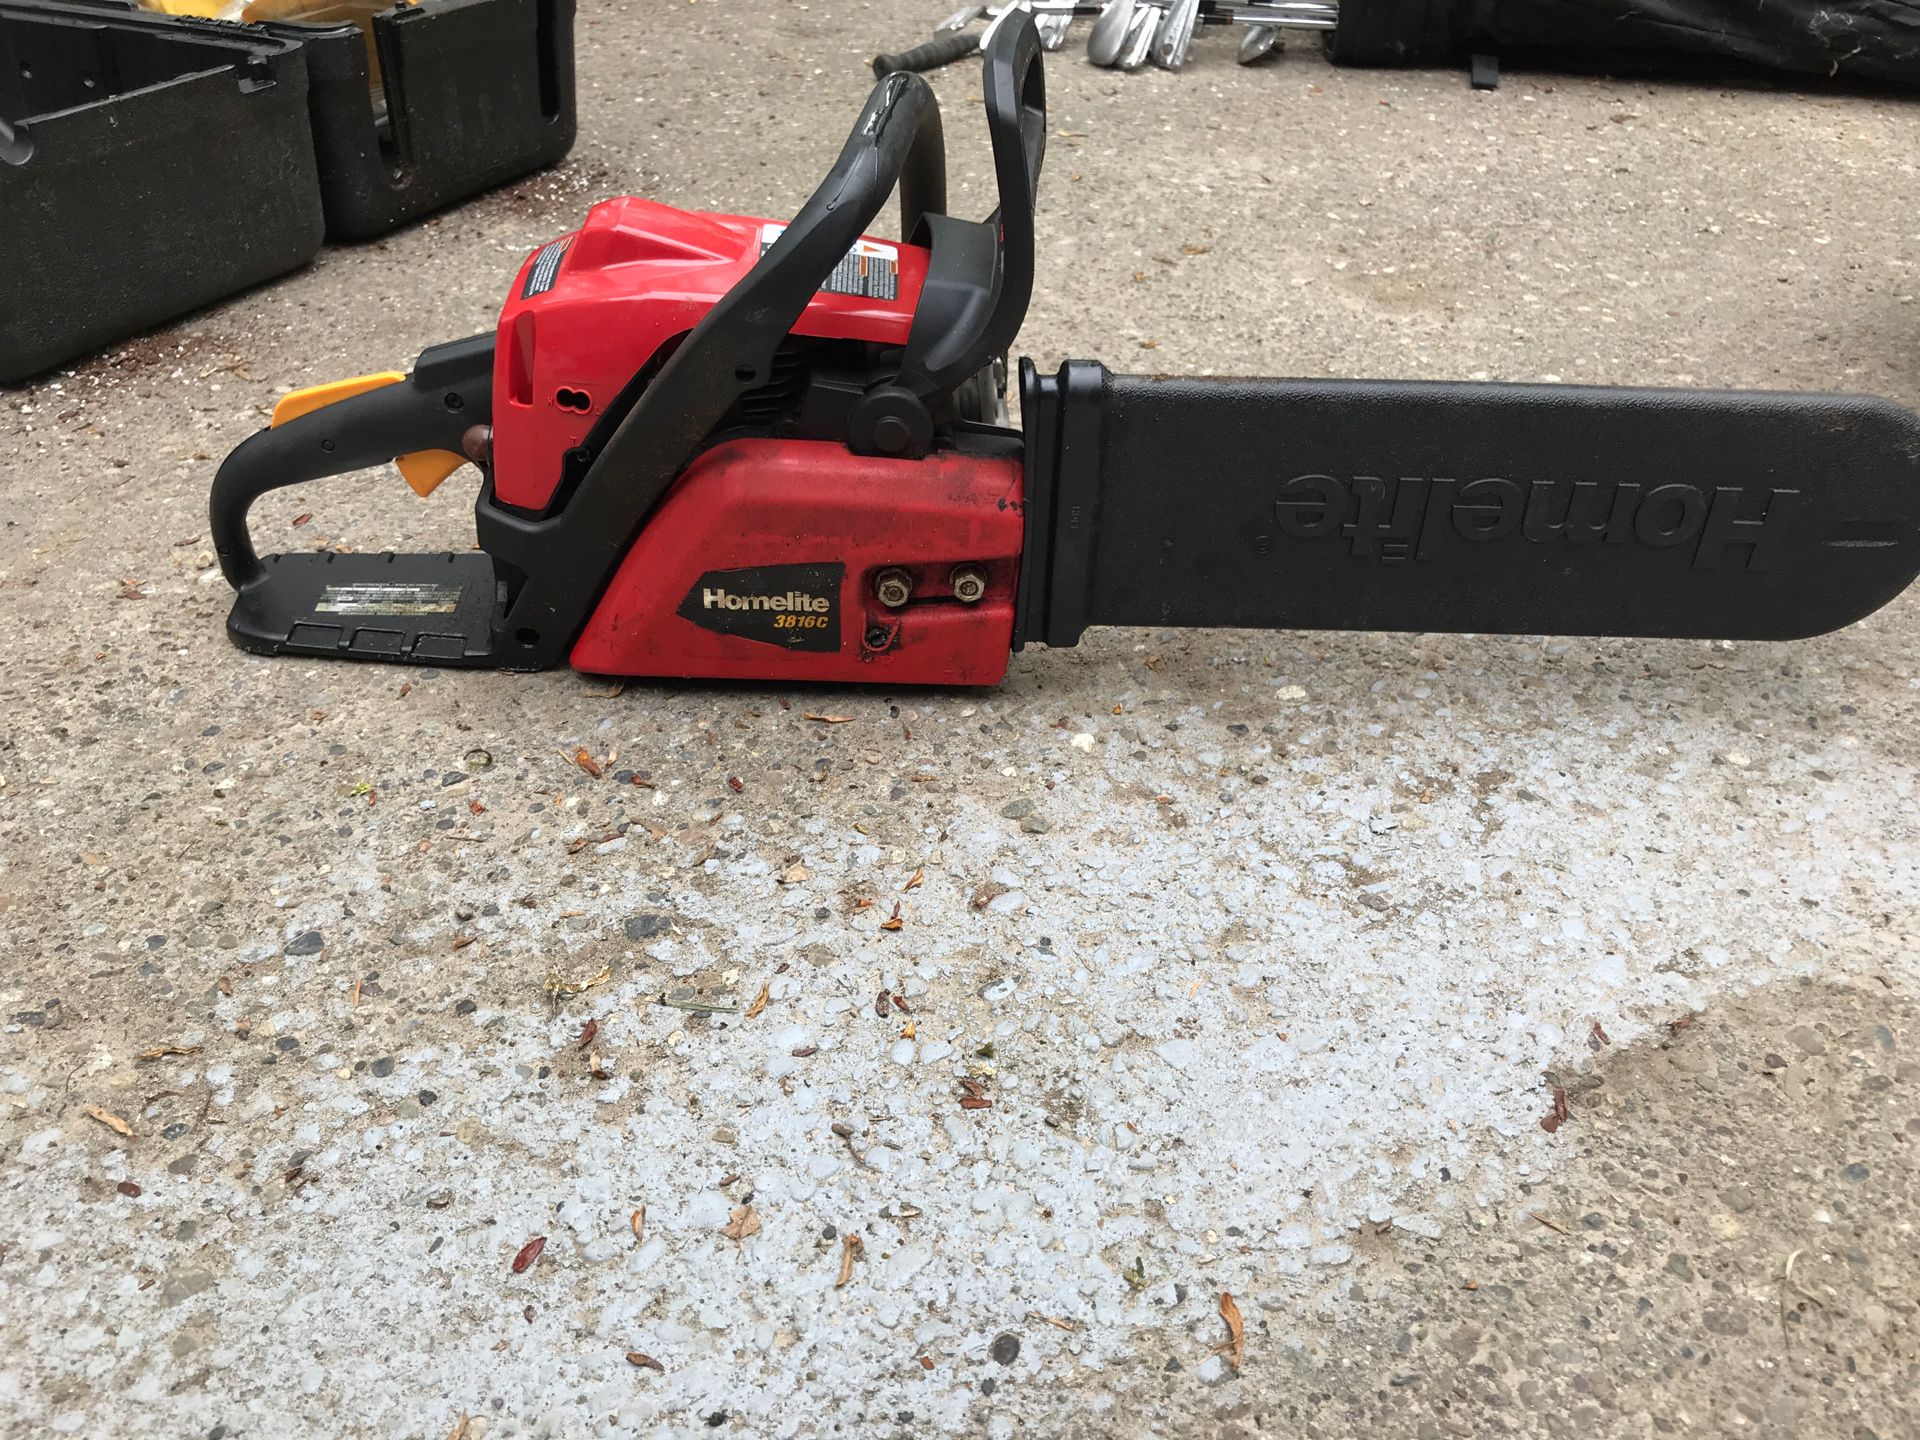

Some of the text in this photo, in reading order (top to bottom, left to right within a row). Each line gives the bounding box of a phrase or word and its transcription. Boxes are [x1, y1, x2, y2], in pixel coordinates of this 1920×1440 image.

[1275, 473, 1801, 570] Homelite
[702, 588, 829, 613] Homelite
[773, 614, 828, 629] 3816C
